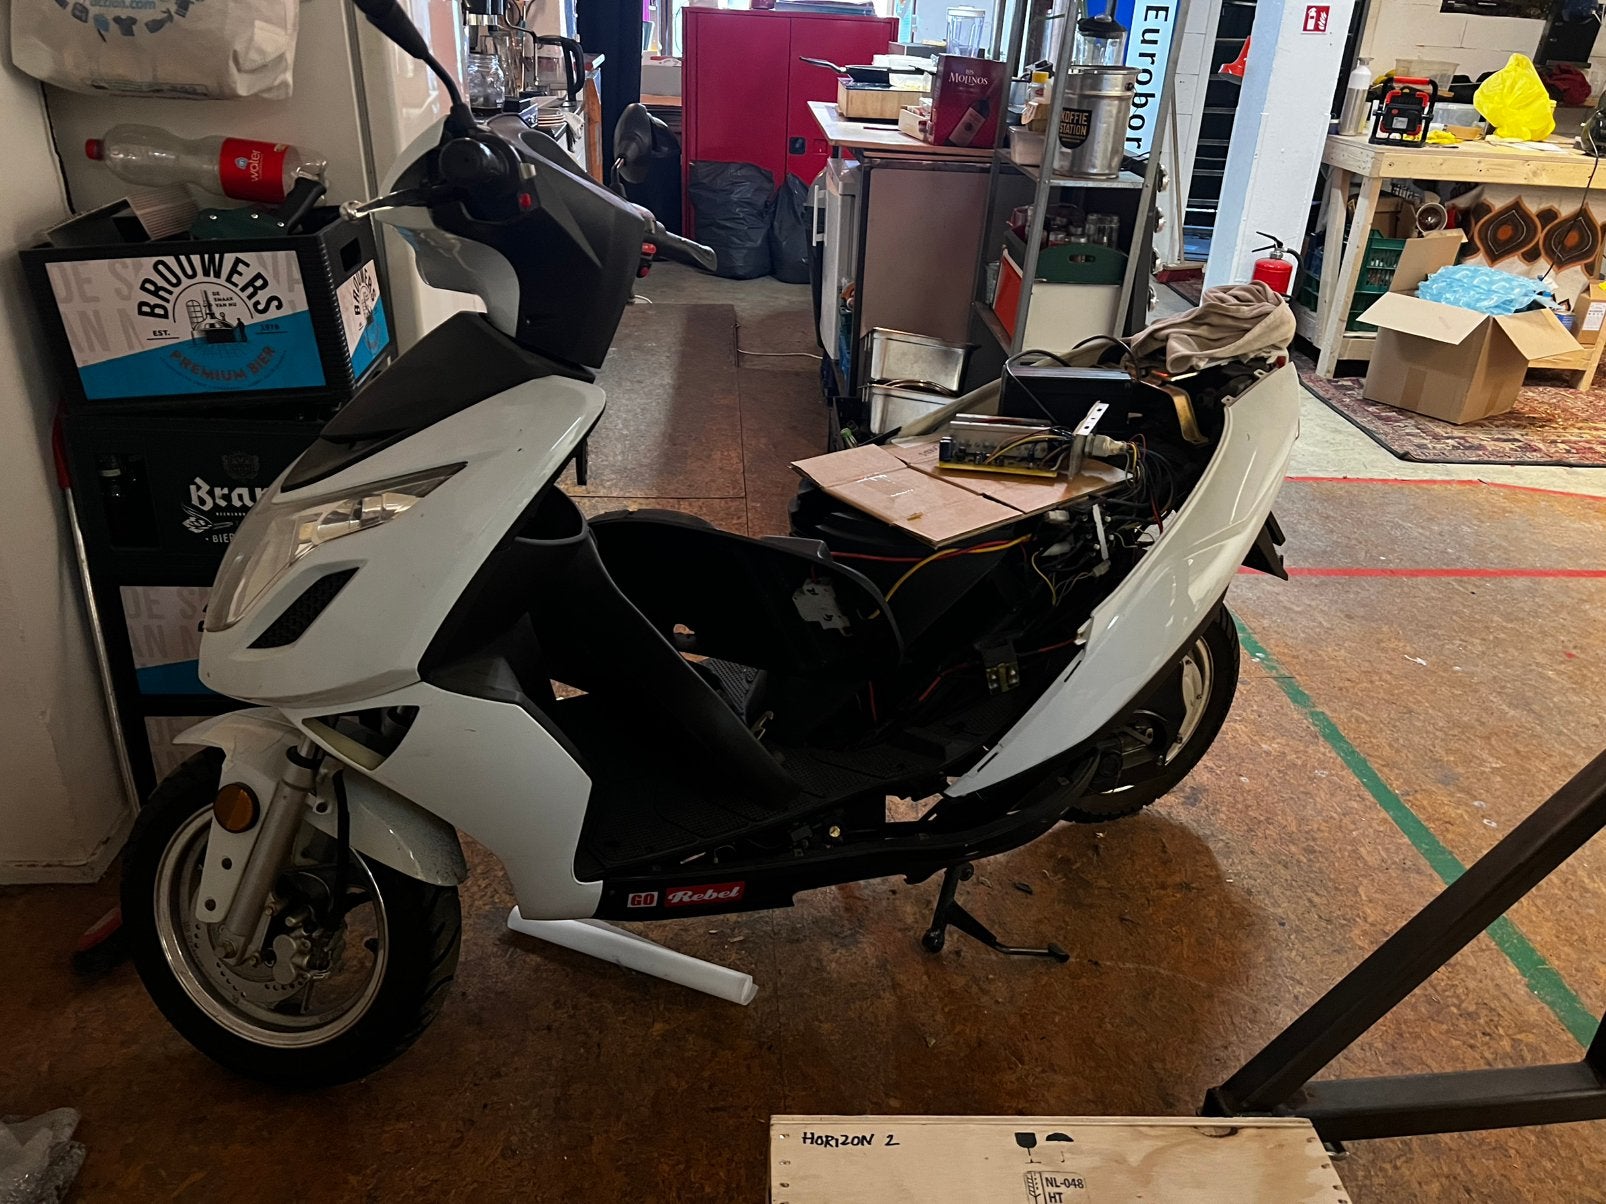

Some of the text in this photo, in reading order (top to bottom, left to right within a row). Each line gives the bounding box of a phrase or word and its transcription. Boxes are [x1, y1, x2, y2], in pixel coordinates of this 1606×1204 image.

[249, 150, 261, 182] water
[137, 253, 284, 319] BROUWERS
[667, 886, 741, 903] Rebel
[802, 1131, 900, 1148] HORIZON 2
[1045, 1176, 1084, 1189] NL-048
[1048, 1192, 1063, 1204] HT
